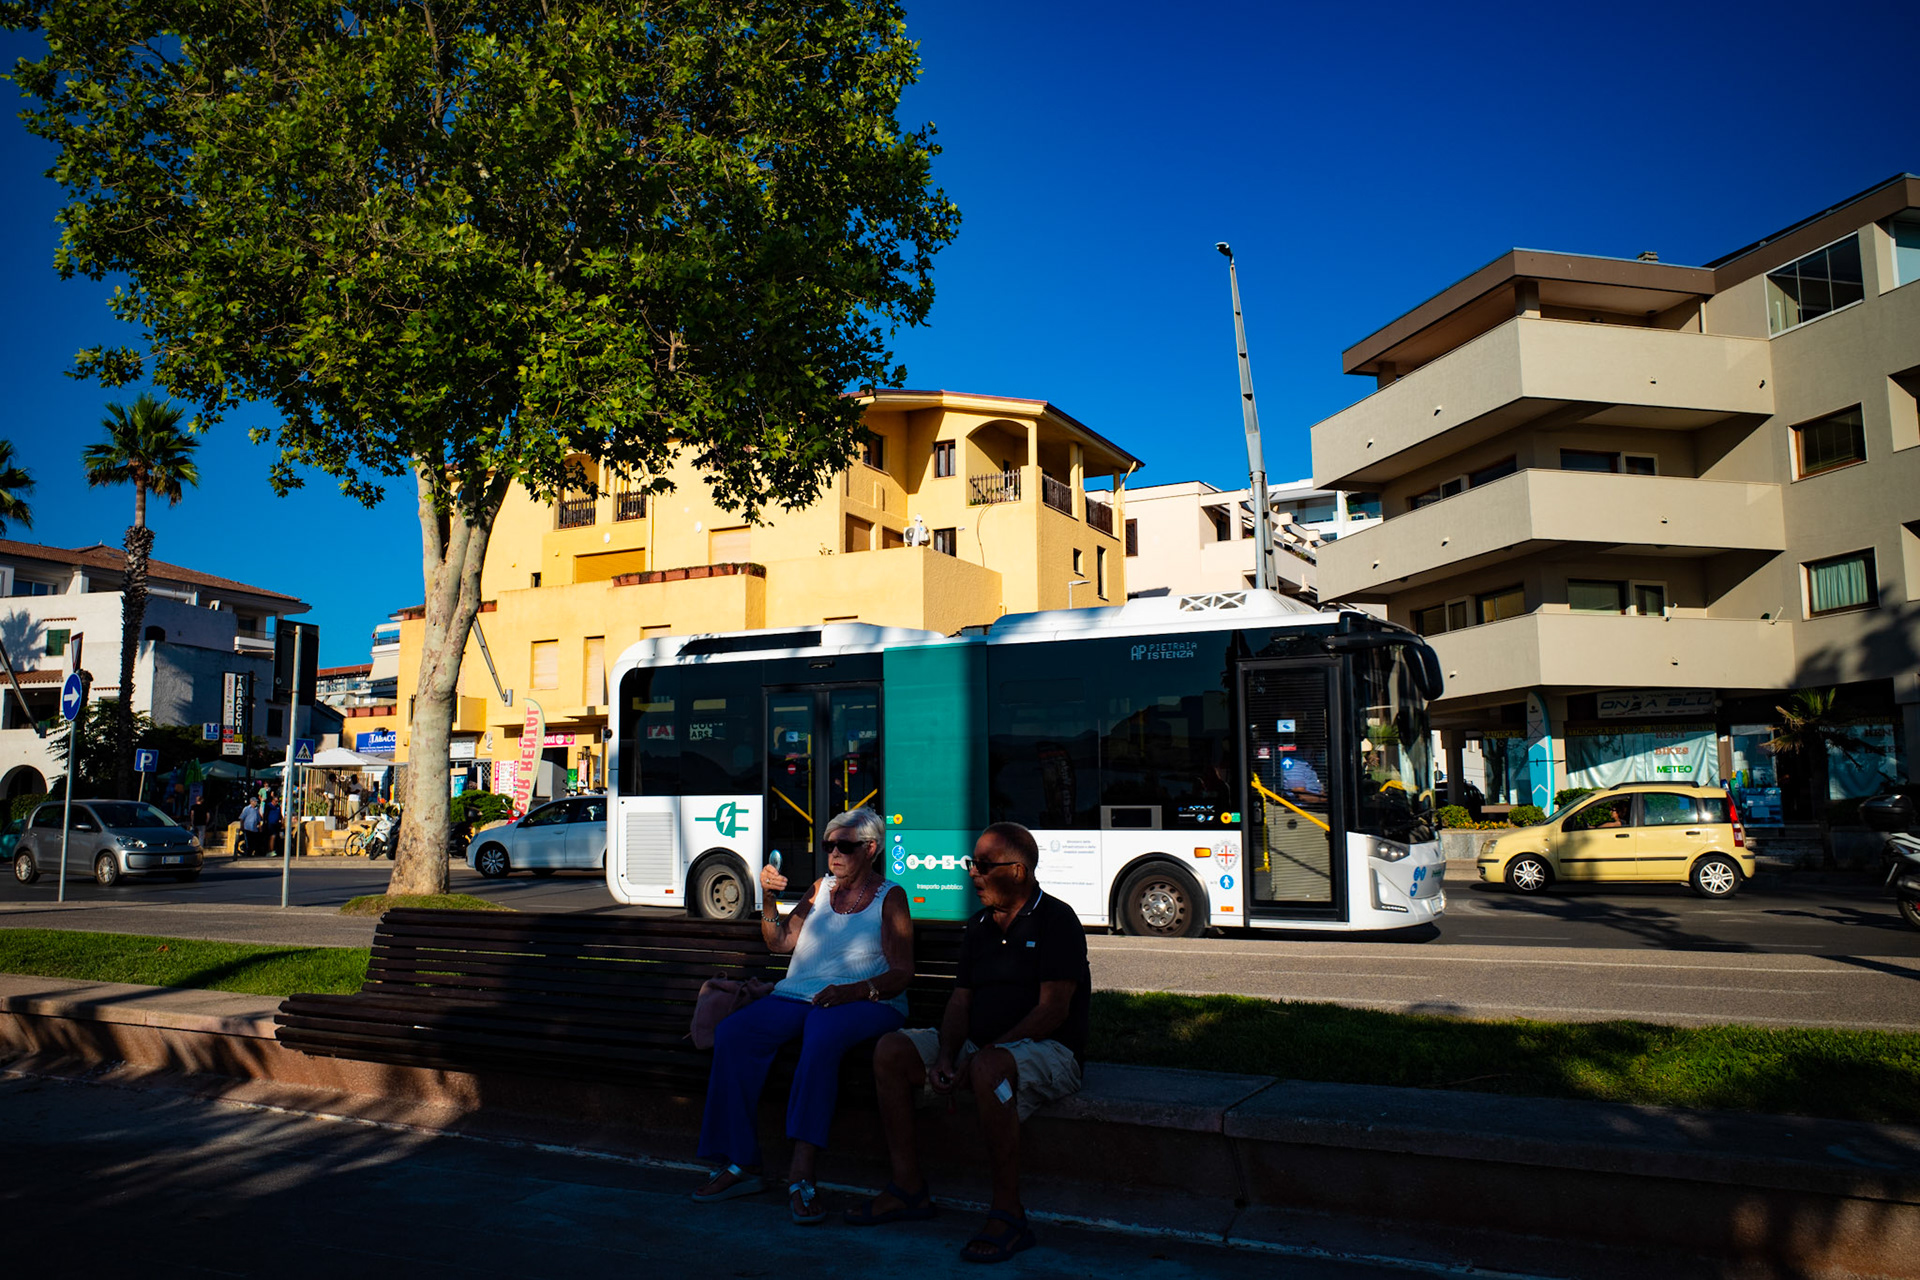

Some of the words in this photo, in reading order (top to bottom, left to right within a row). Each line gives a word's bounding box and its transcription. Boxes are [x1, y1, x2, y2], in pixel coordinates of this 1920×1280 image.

[1149, 642, 1198, 652] PIETRAIA
[1147, 649, 1195, 660] ISTENZA
[235, 674, 243, 735] TABACCHI
[1655, 746, 1689, 755] BIKES
[141, 752, 153, 769] P
[1656, 765, 1692, 773] METEO
